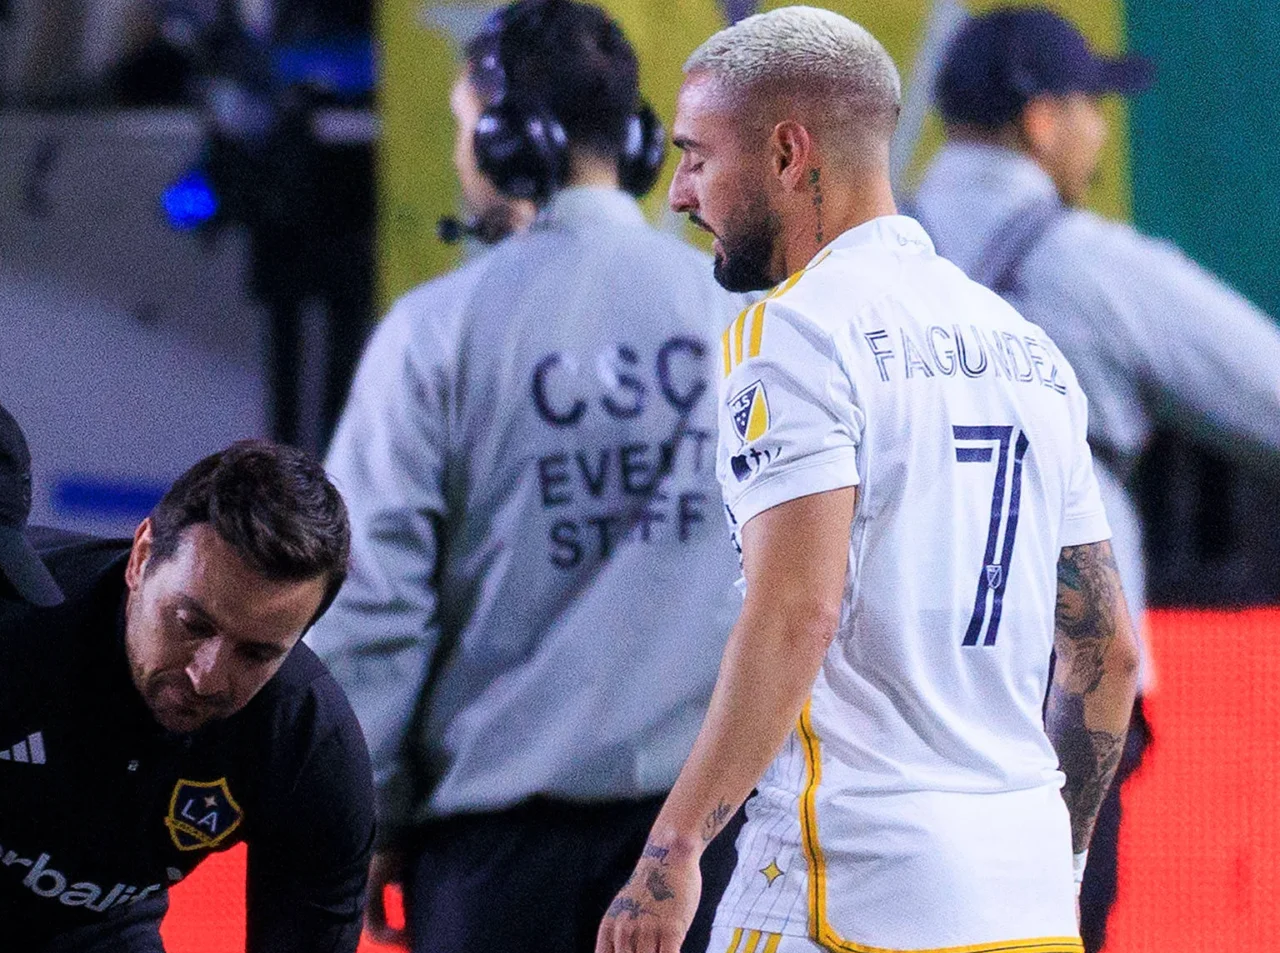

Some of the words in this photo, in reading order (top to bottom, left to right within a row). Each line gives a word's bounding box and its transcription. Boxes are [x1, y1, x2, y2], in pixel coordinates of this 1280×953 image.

[531, 335, 708, 428] CSC
[548, 491, 708, 570] STFF
[952, 424, 1030, 647] 7
[181, 798, 218, 834] LA
